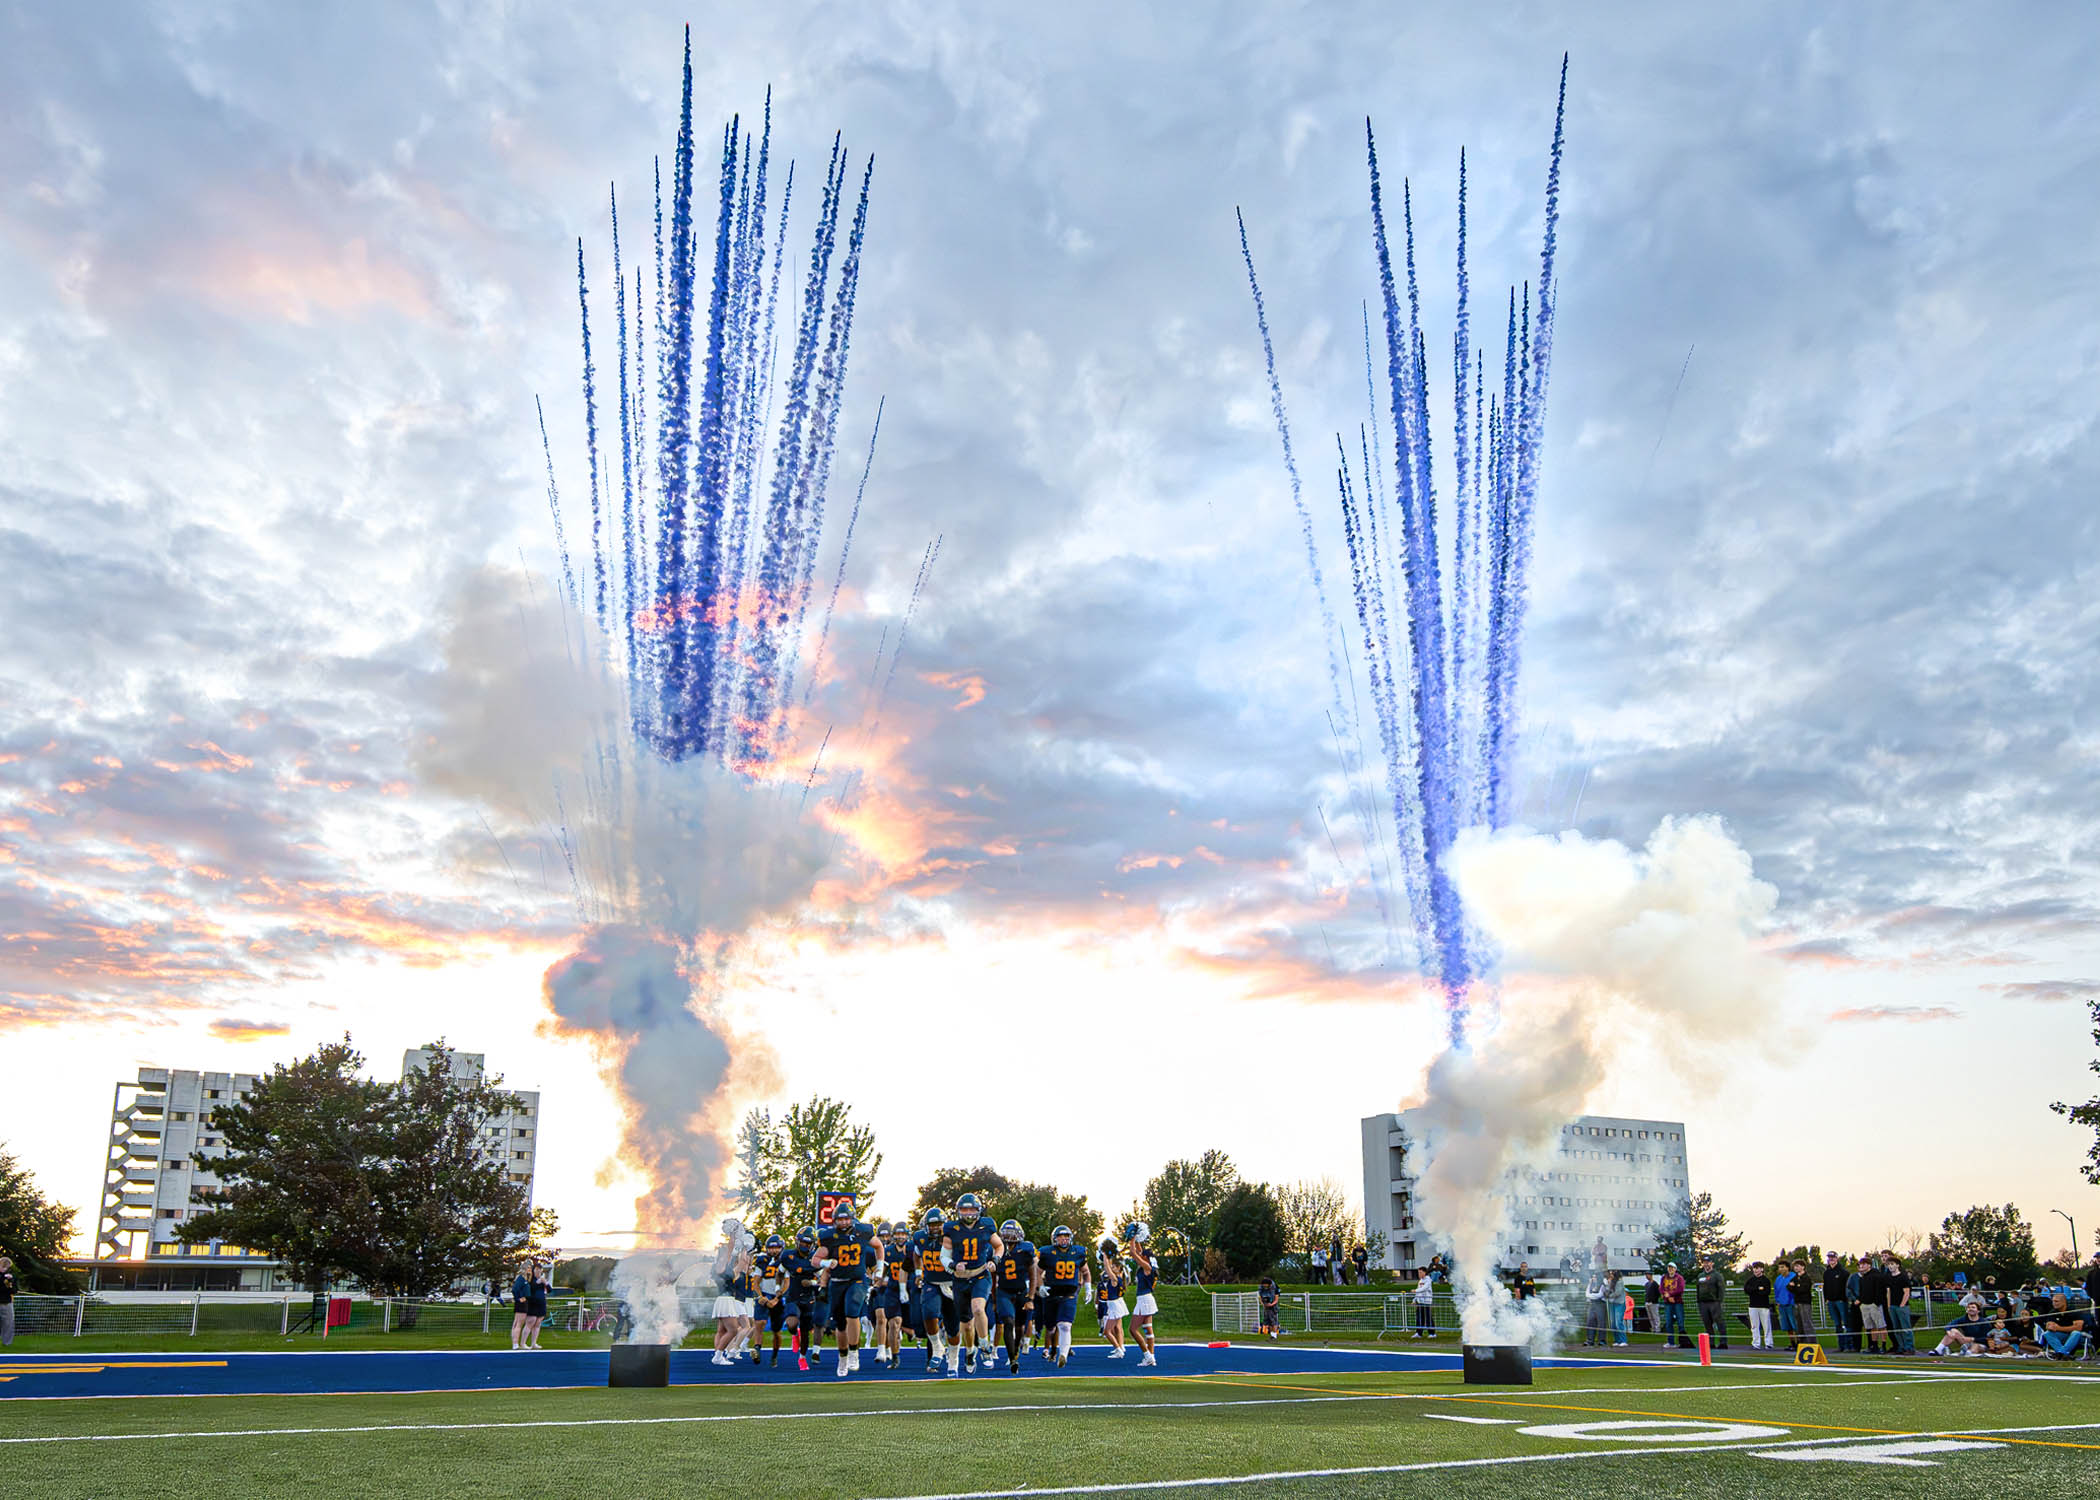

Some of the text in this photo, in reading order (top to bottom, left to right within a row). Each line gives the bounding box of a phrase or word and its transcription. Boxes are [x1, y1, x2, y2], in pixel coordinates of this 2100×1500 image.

[838, 1243, 861, 1267] 63
[962, 1237, 979, 1261] 11
[923, 1250, 945, 1272] 65
[1005, 1260, 1017, 1280] 2
[1055, 1261, 1076, 1279] 99
[1799, 1346, 1815, 1364] G
